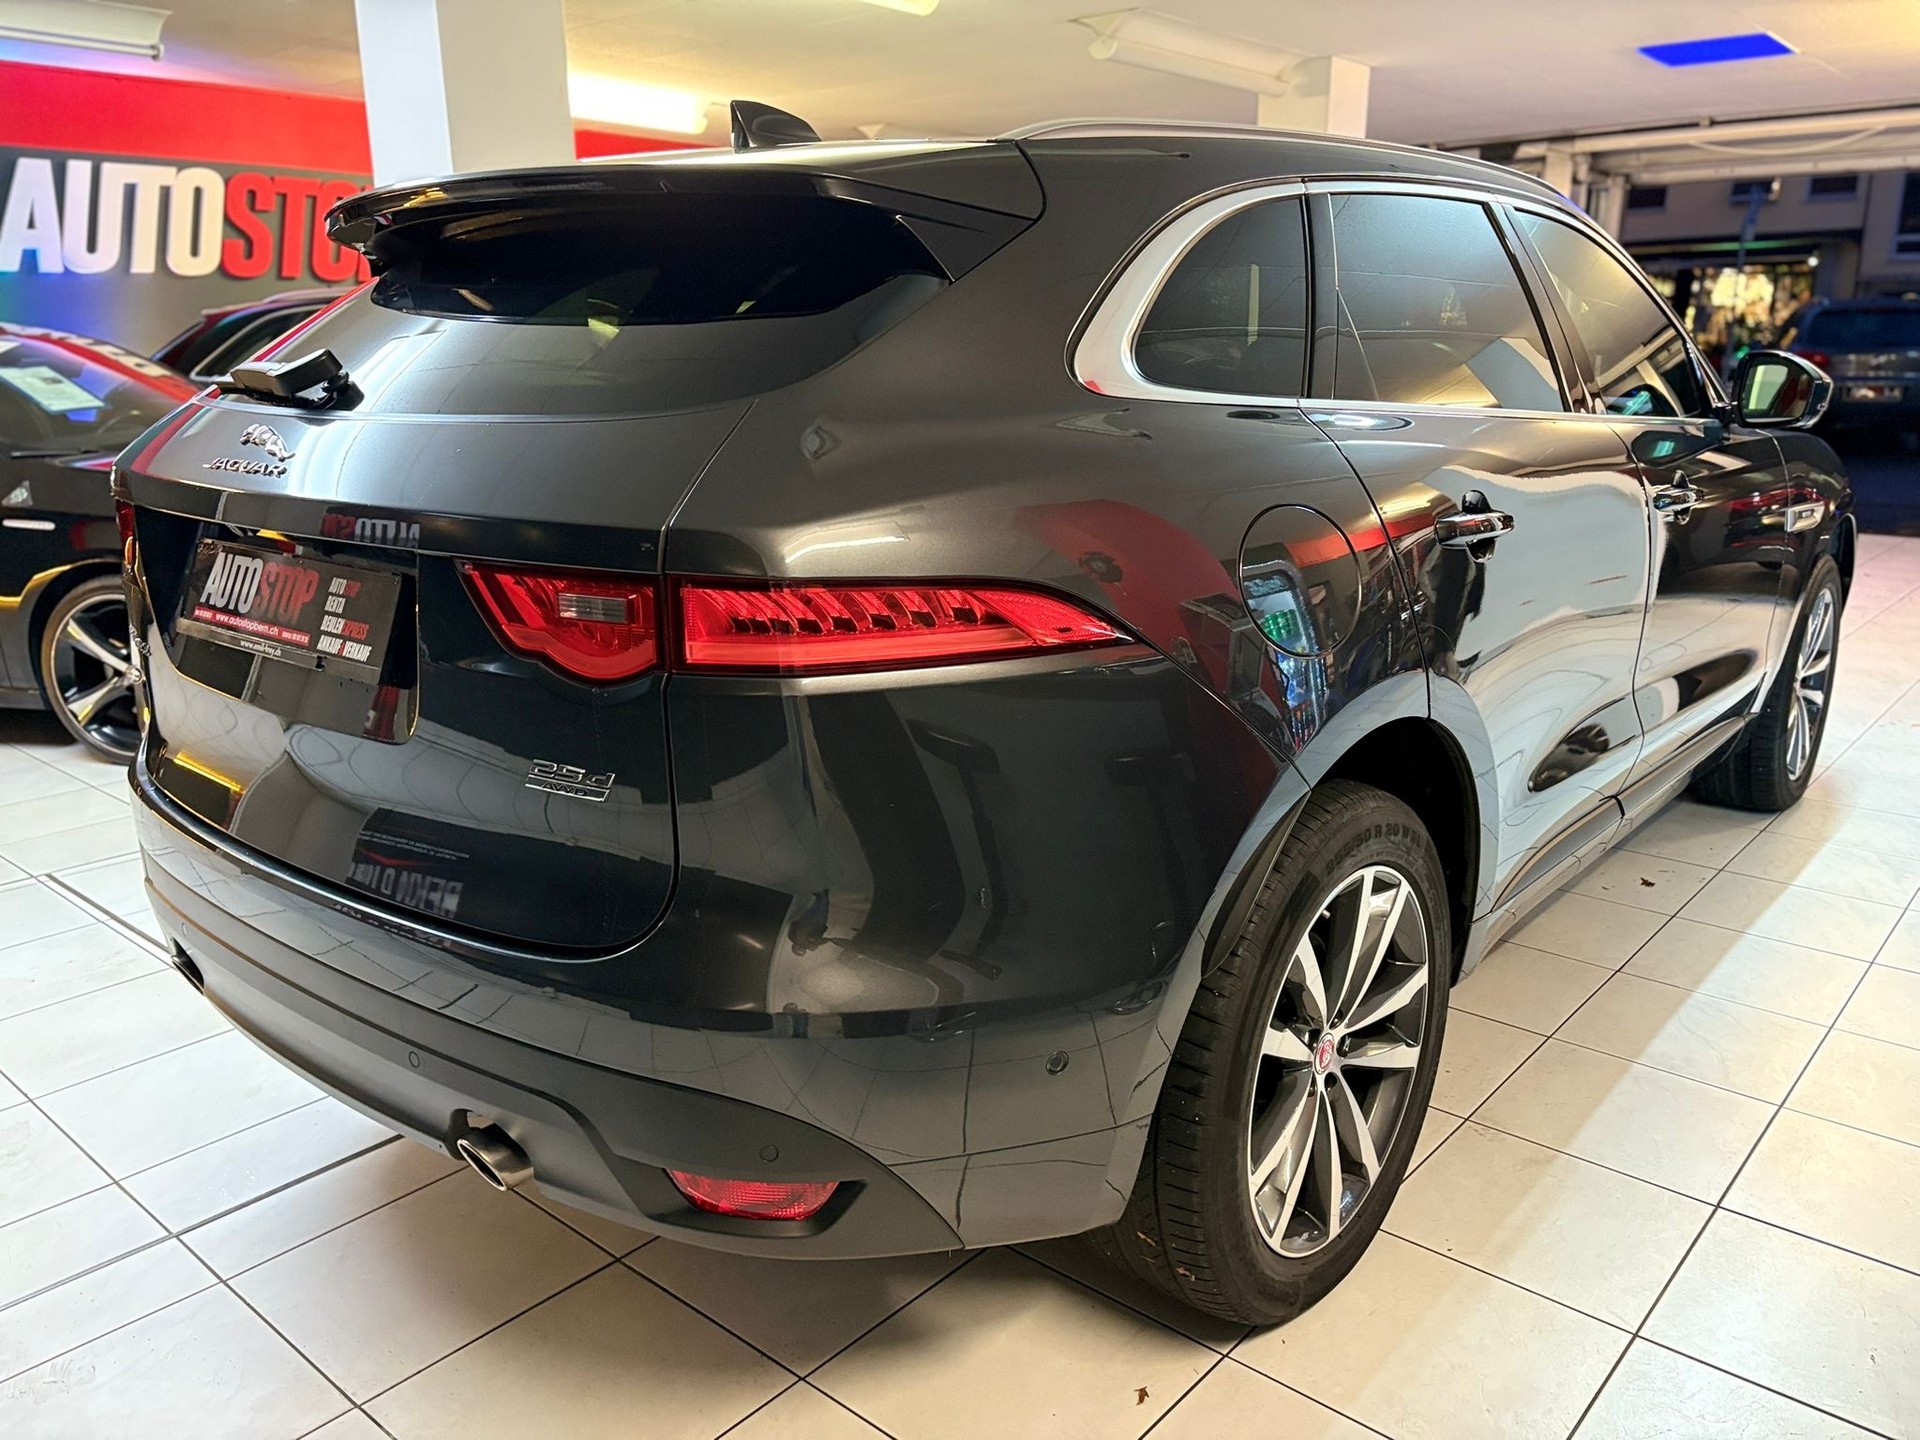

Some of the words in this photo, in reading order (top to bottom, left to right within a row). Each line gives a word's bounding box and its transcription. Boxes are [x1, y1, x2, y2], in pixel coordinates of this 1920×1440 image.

[0, 156, 372, 283] AUTOSTO
[202, 457, 287, 478] JAGUAR
[199, 551, 320, 625] AUTOSTOP
[529, 759, 615, 789] 25d
[541, 781, 589, 797] AWD
